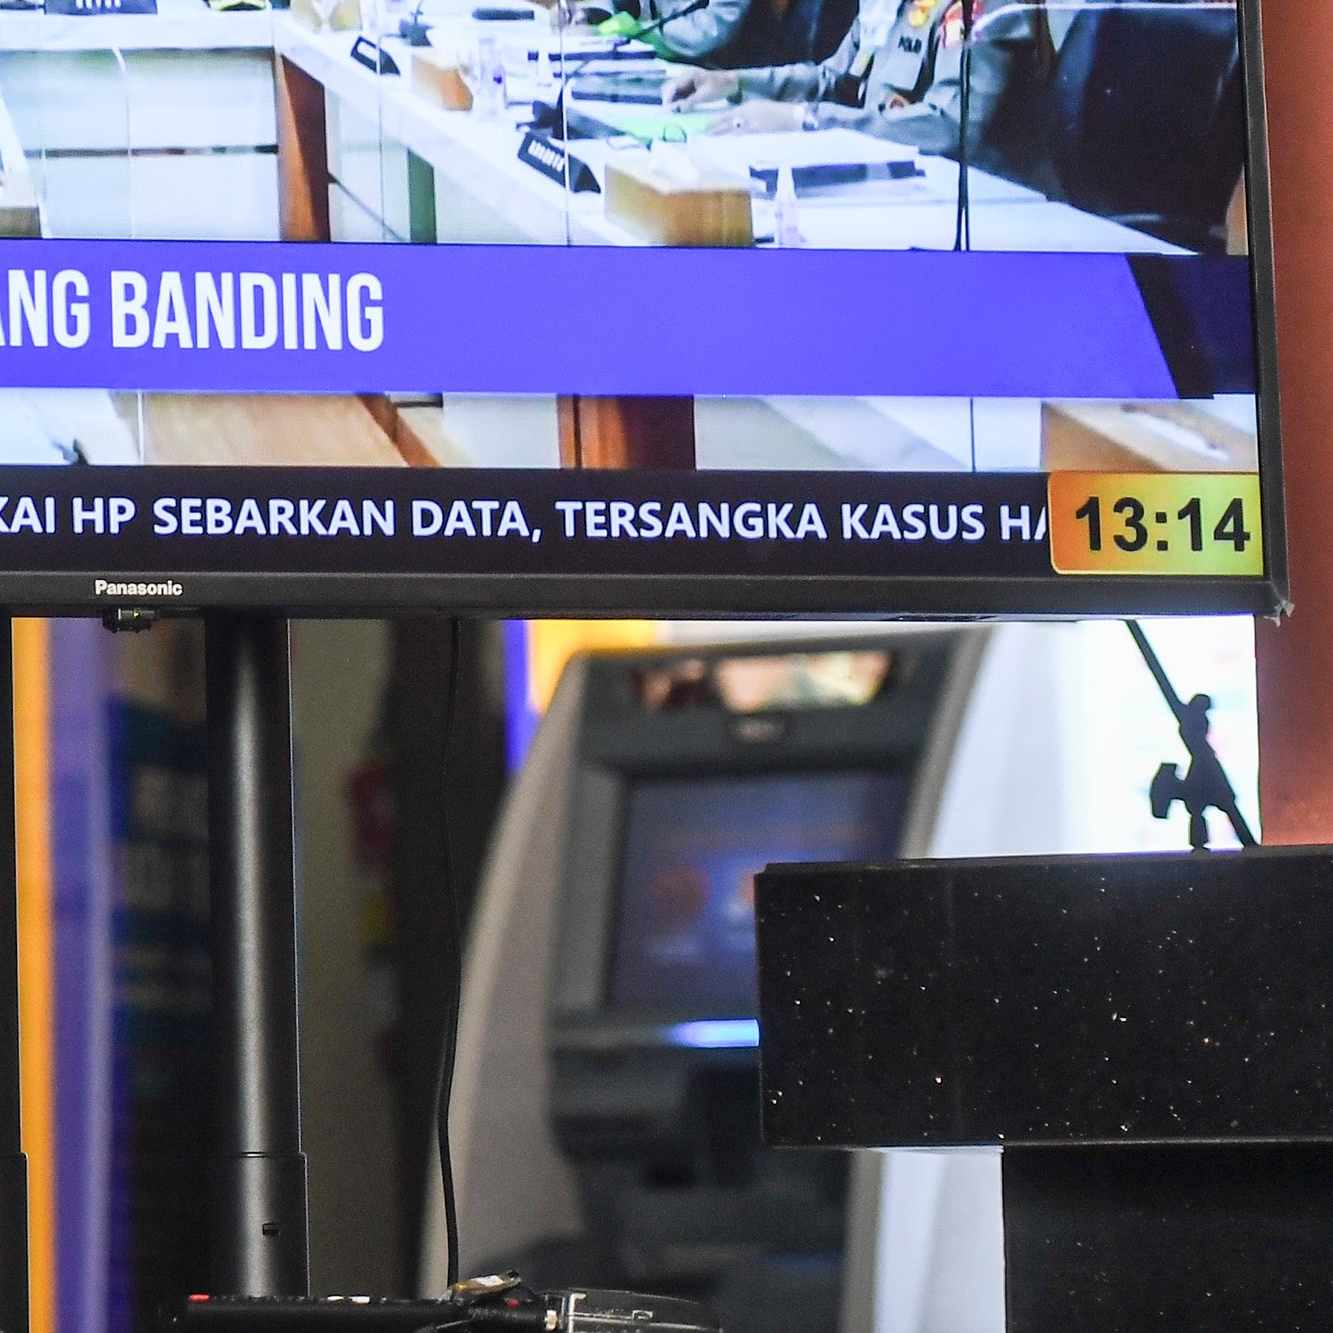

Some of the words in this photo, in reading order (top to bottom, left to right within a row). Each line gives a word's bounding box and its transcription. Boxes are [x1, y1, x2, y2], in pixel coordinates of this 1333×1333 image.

[110, 270, 385, 352] BANDING
[72, 497, 135, 534] HP
[152, 497, 395, 536] SEBARKAN
[412, 500, 541, 543] DATA,
[555, 501, 828, 539] TERSANGKA
[841, 503, 985, 540] KASUS
[1075, 495, 1251, 553] 13:14
[94, 578, 183, 596] Panasonic
